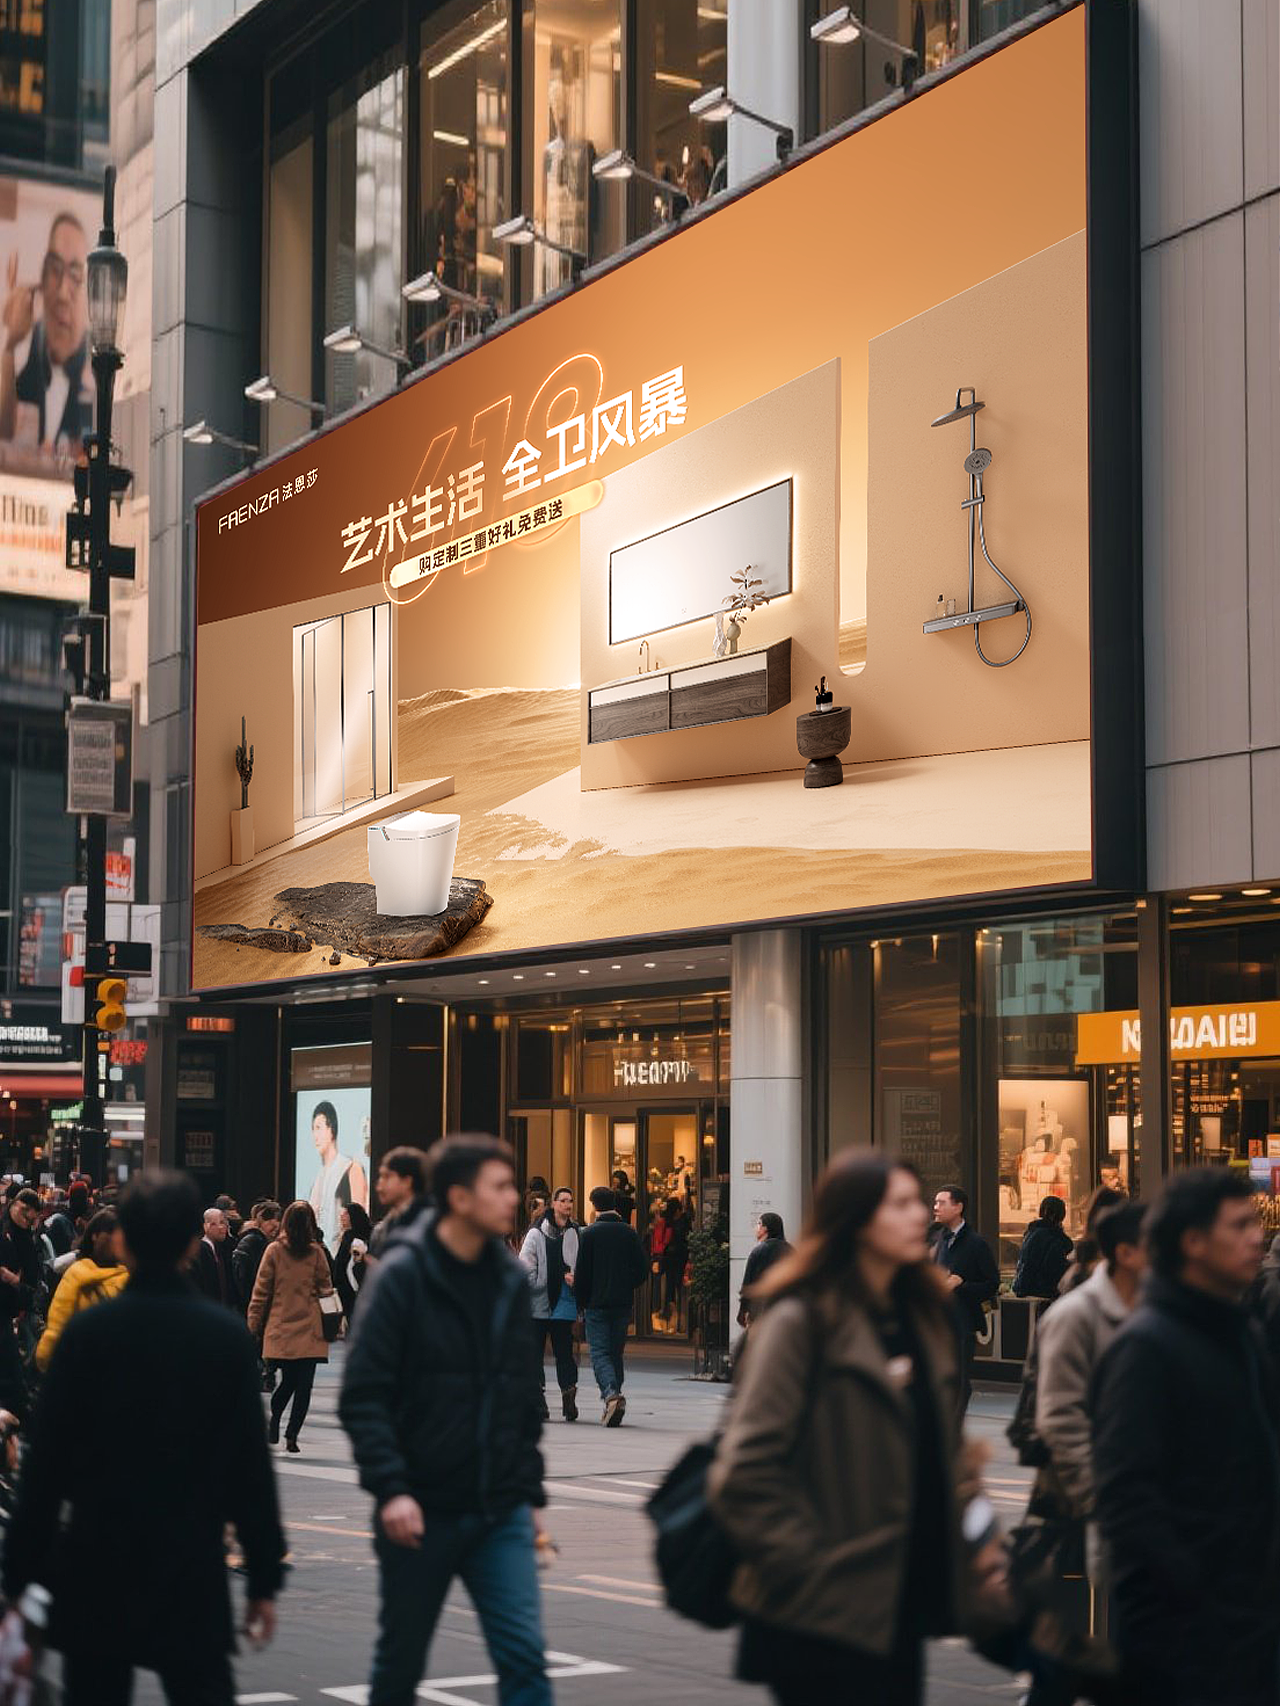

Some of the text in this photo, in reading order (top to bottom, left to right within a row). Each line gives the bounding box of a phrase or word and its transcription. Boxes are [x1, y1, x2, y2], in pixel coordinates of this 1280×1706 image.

[218, 467, 319, 535] FAENZA 法恩莎
[340, 365, 688, 574] 艺术生活 全卫风暴
[419, 498, 563, 575] 购定制三重好礼免费送
